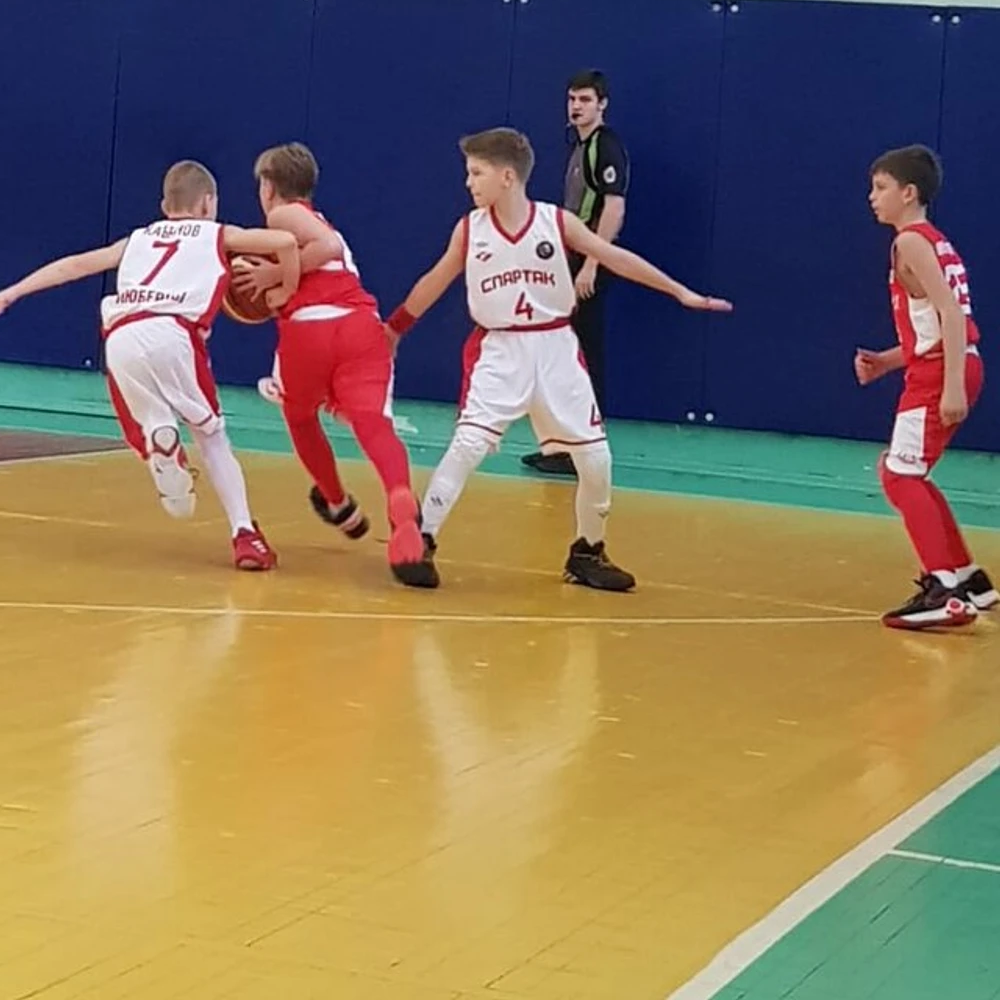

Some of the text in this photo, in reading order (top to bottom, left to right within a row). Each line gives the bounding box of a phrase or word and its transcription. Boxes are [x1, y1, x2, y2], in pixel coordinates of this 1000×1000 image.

[139, 238, 181, 286] 7
[480, 269, 556, 294] СПАРТАК
[514, 291, 534, 321] 4
